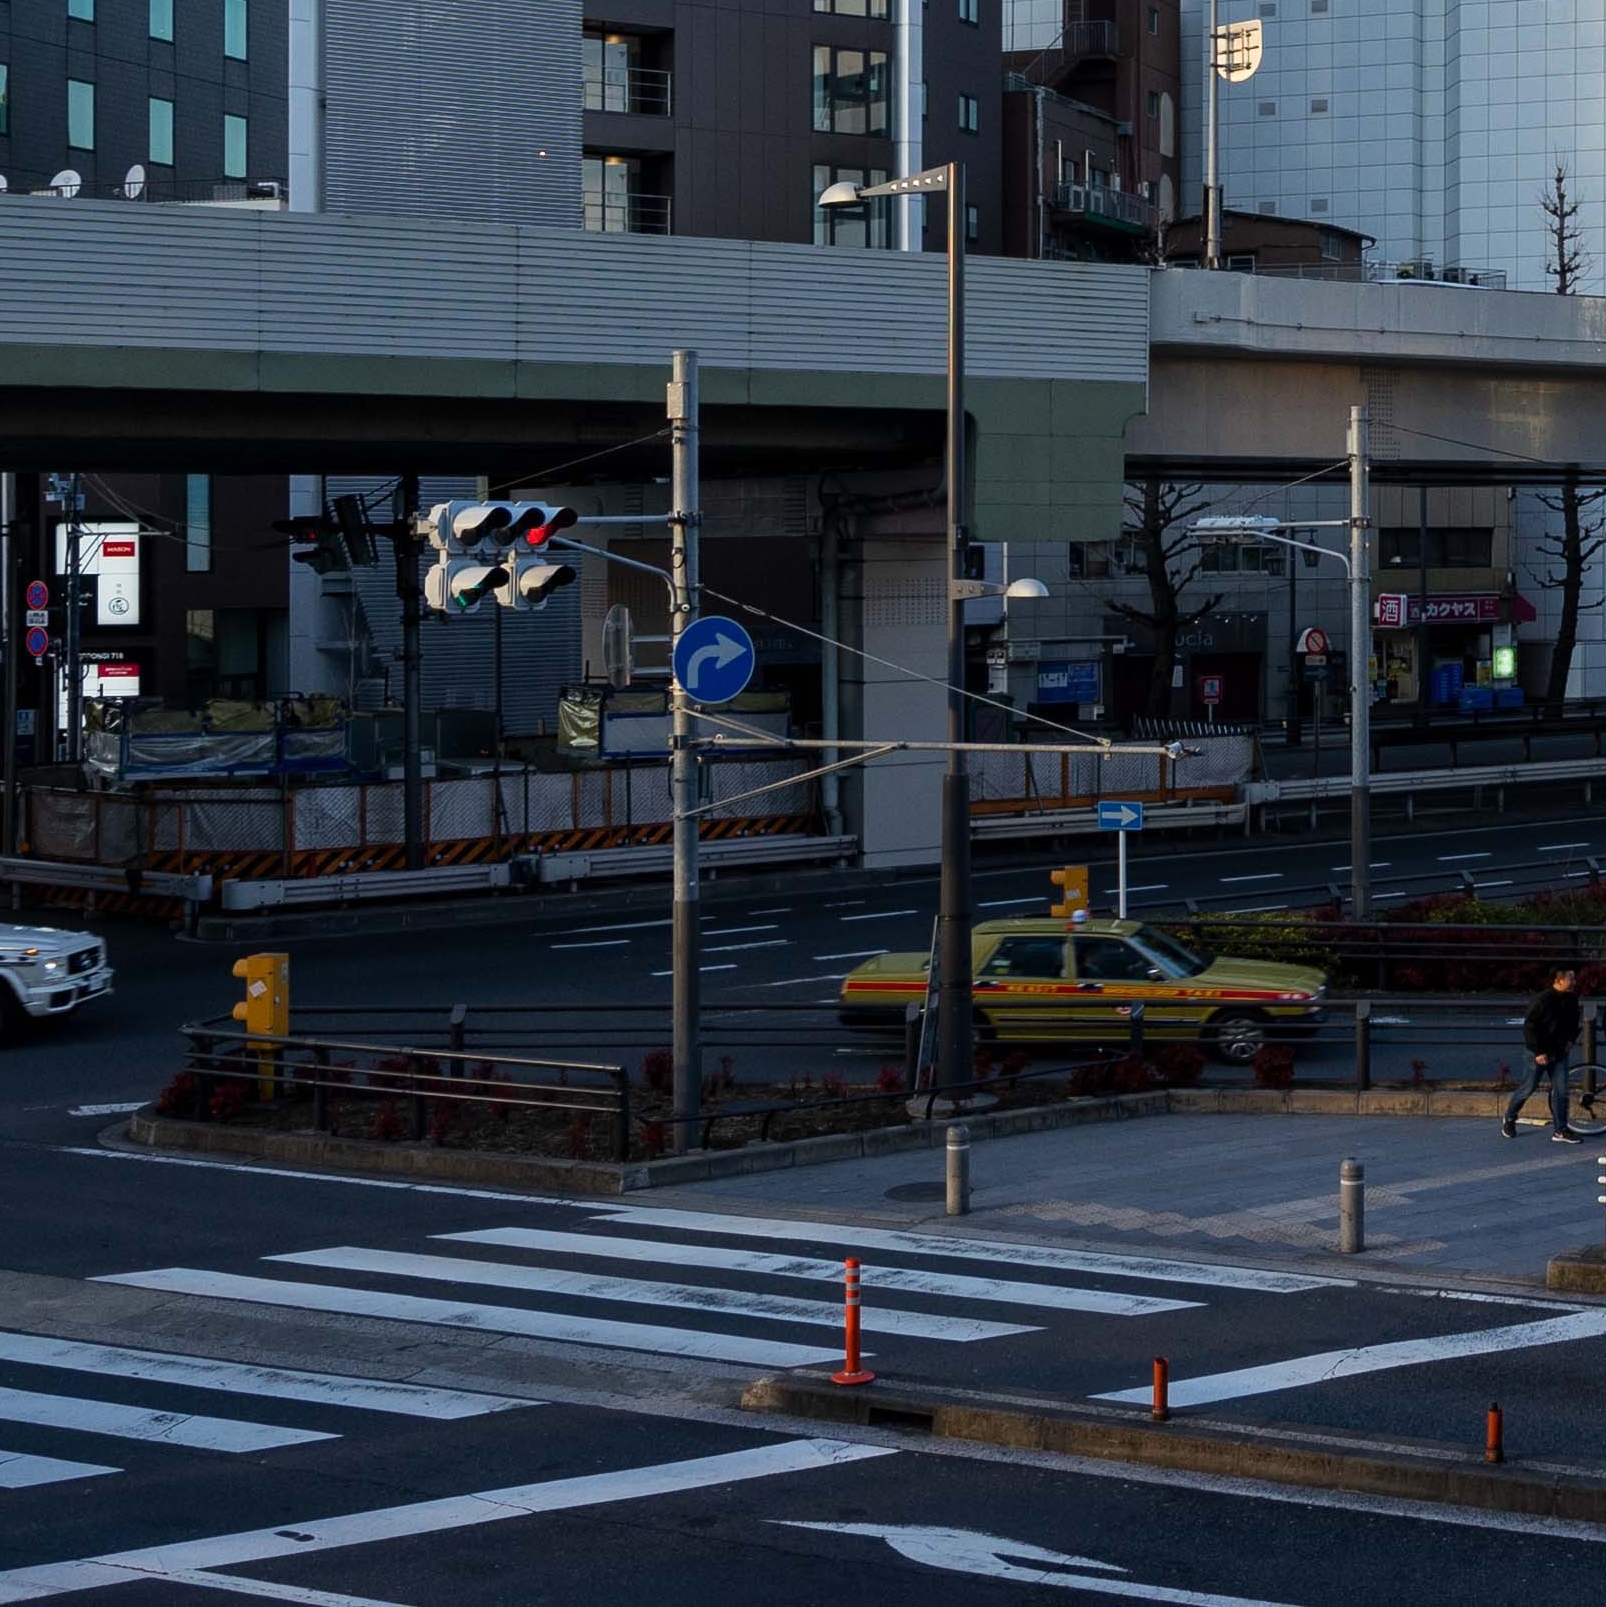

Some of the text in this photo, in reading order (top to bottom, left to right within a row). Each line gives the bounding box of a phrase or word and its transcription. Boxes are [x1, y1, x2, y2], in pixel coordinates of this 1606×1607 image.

[1381, 600, 1400, 623] 酒
[1425, 601, 1476, 619] カクヤス
